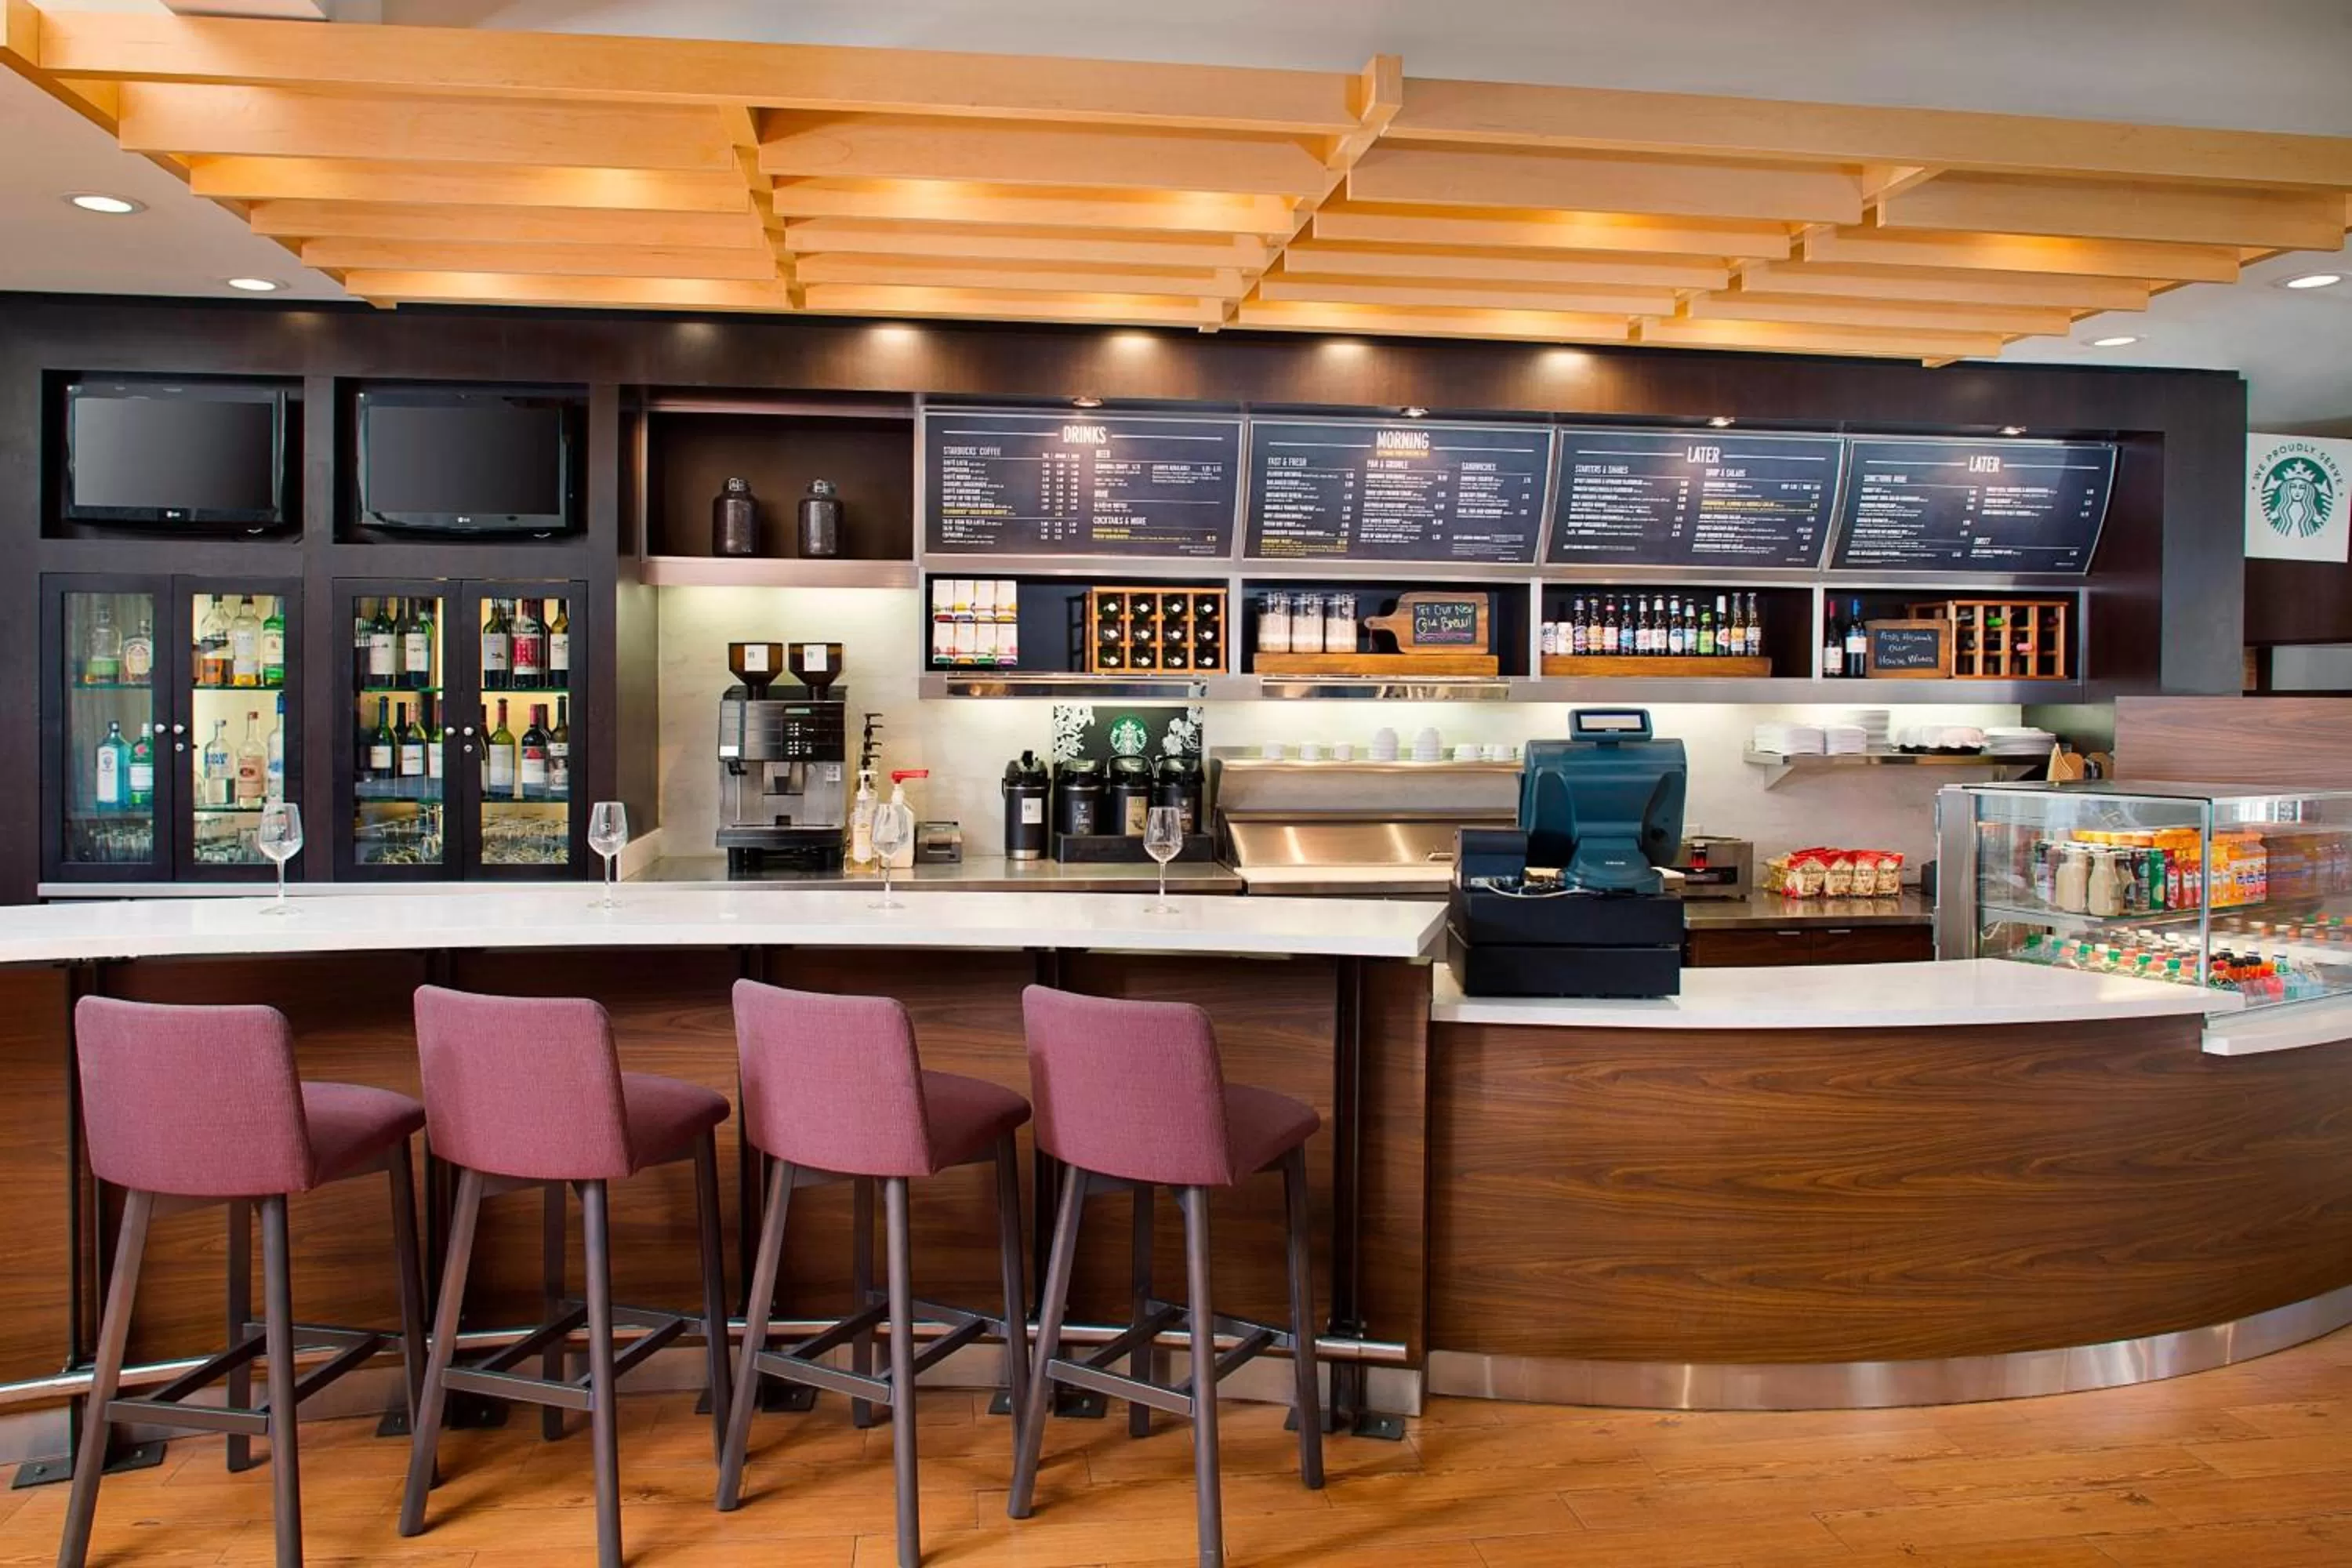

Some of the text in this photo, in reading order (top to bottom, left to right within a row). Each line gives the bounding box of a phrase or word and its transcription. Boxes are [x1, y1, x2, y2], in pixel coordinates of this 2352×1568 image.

[1063, 425, 1107, 445] DRINKS
[1377, 431, 1430, 450] MORNING
[1687, 446, 1720, 463] LATER
[1969, 456, 2000, 472] LATER
[2252, 463, 2266, 480] WE
[2266, 443, 2316, 462] PROUDLY
